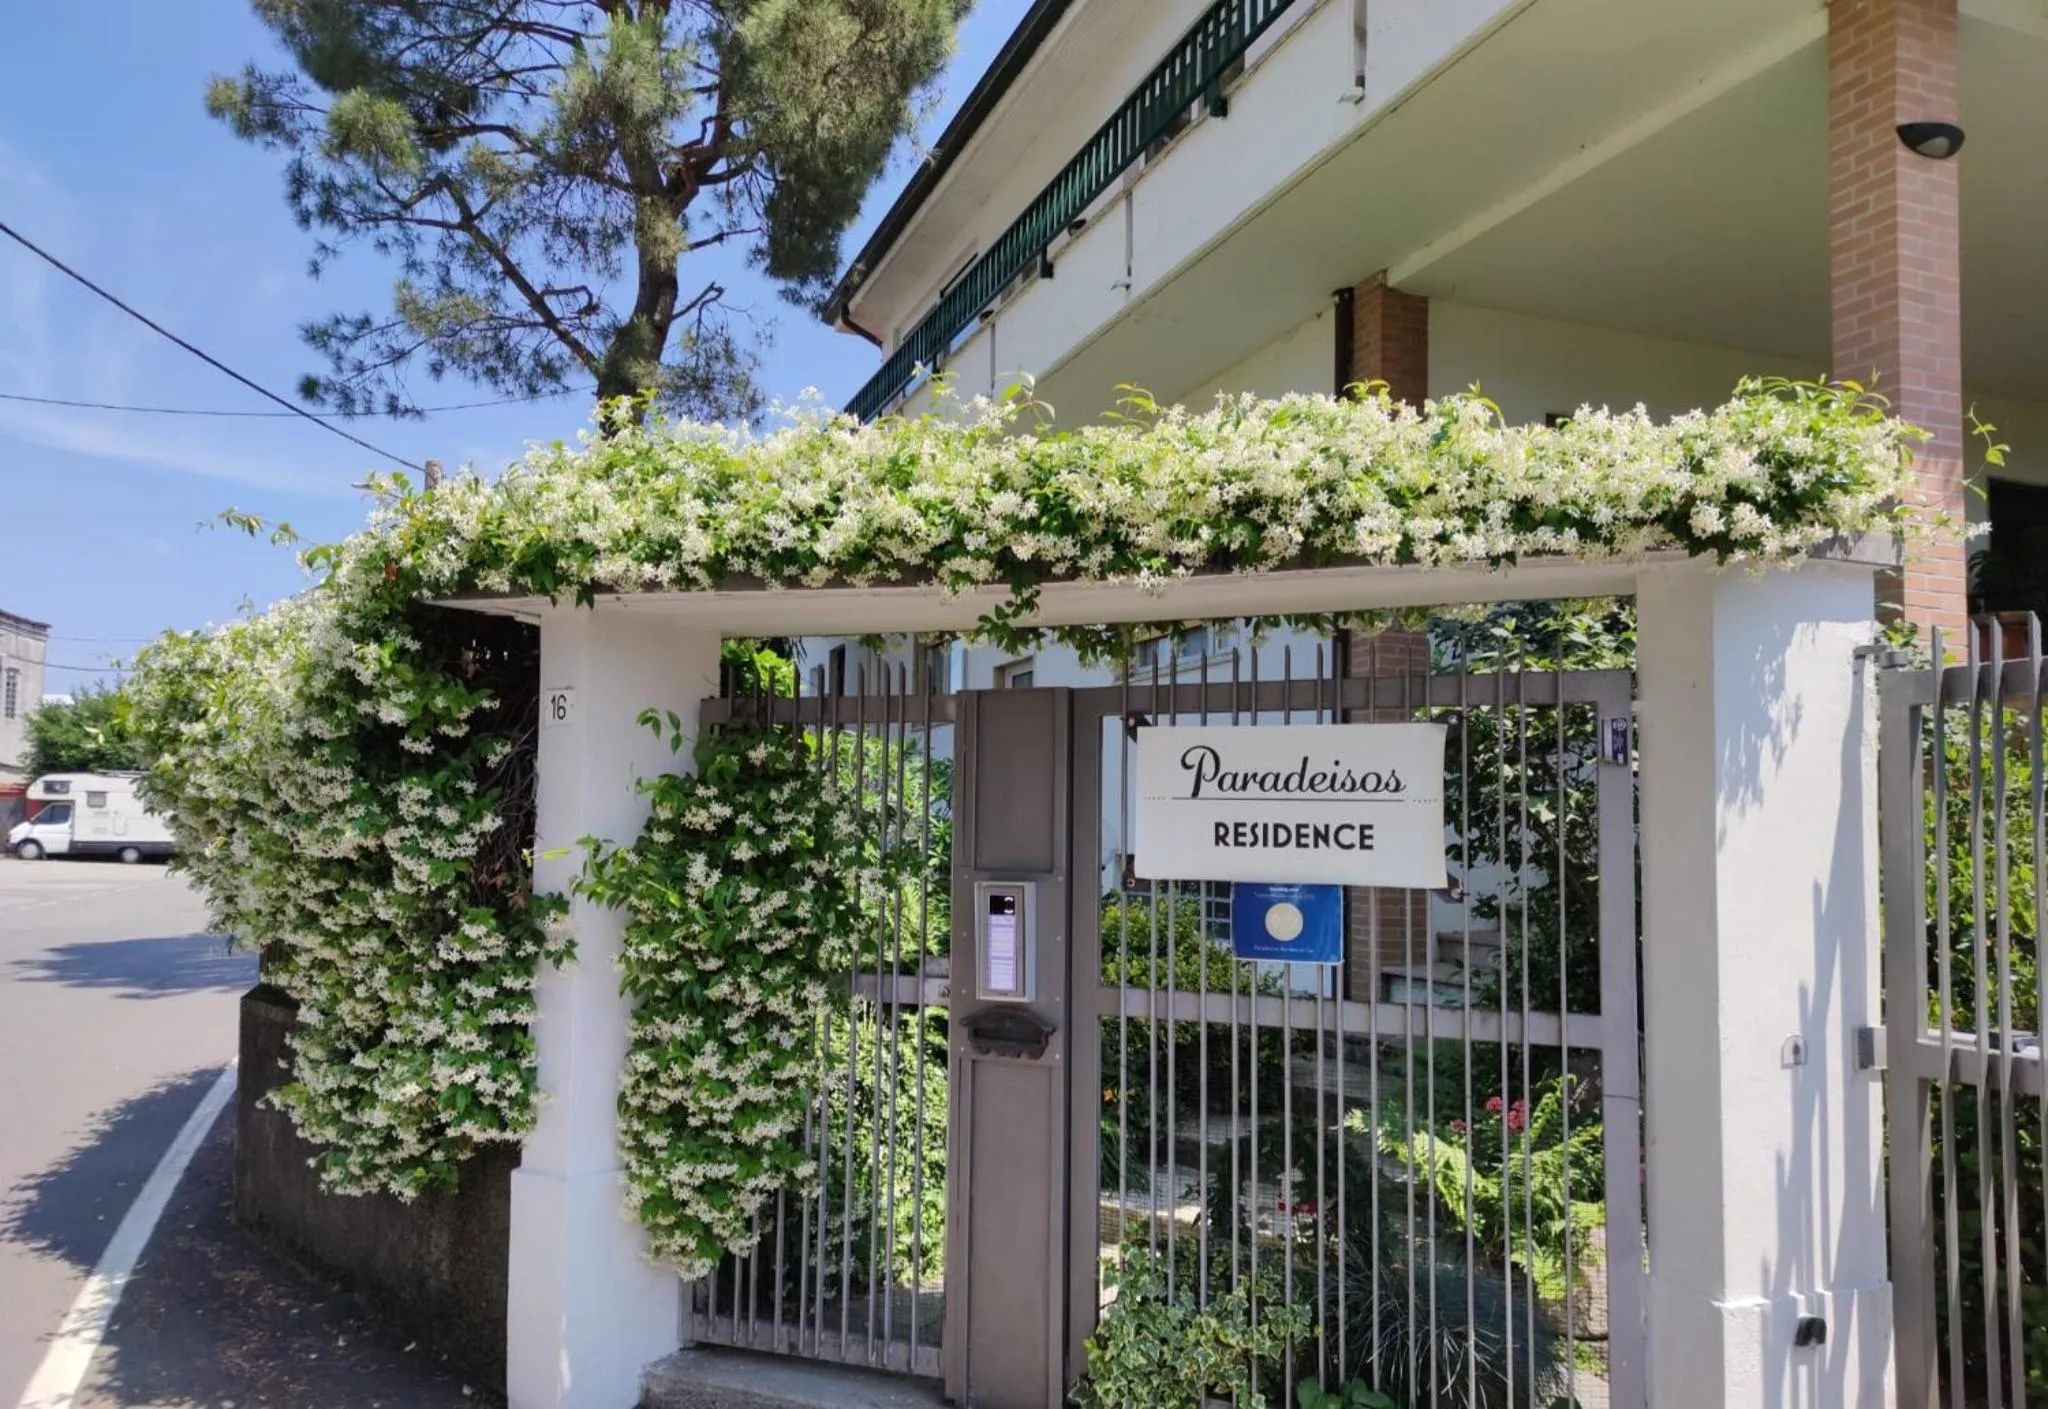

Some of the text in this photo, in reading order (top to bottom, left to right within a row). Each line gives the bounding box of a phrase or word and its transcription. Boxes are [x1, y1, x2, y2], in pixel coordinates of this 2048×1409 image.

[551, 694, 567, 720] 16
[1180, 745, 1406, 798] Paradeisos
[1214, 821, 1374, 850] RESIDENCE
